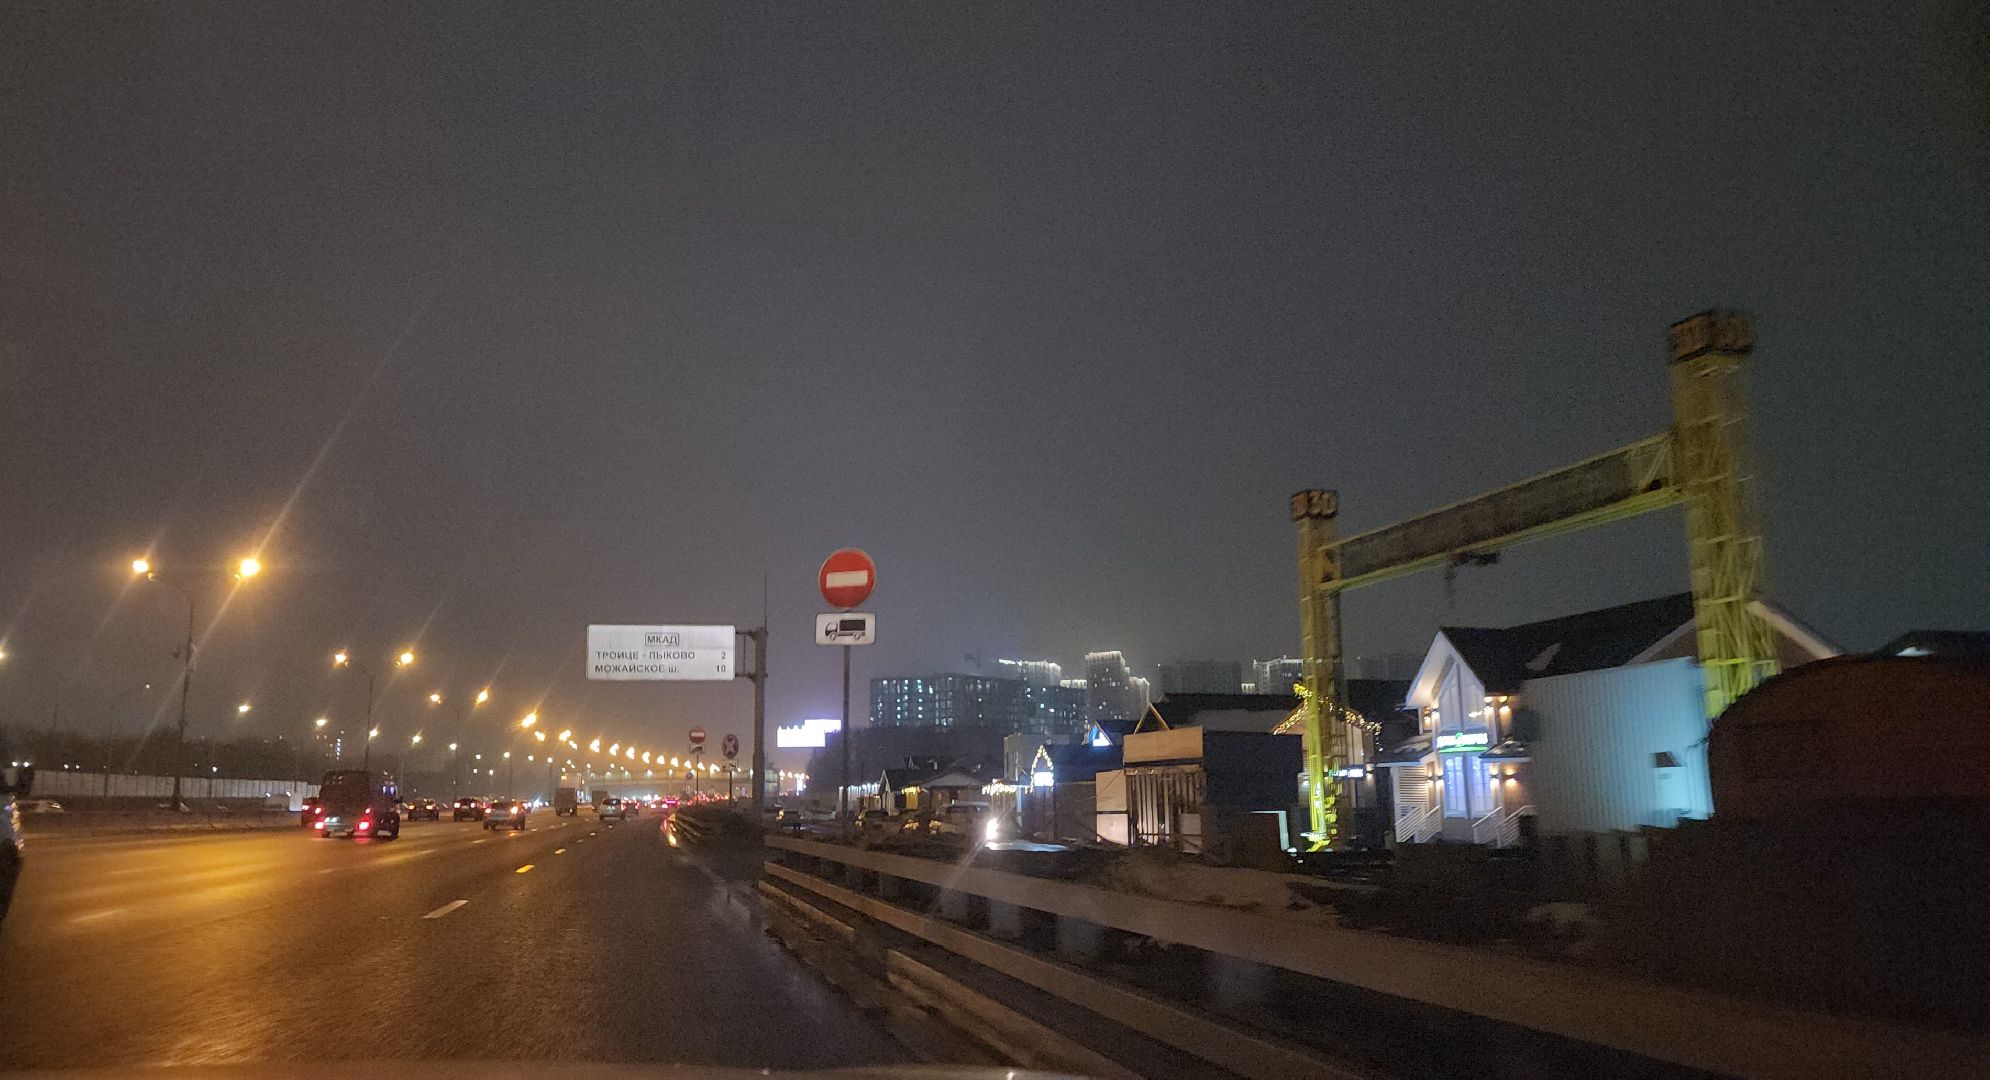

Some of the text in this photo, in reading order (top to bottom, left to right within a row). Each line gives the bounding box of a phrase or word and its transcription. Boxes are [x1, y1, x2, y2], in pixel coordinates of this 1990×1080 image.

[647, 635, 678, 646] МКАД
[596, 651, 639, 660] ТРОИЦЕ
[649, 651, 695, 659] ЛЫКОВО
[721, 651, 727, 660] 2
[716, 664, 726, 673] 10
